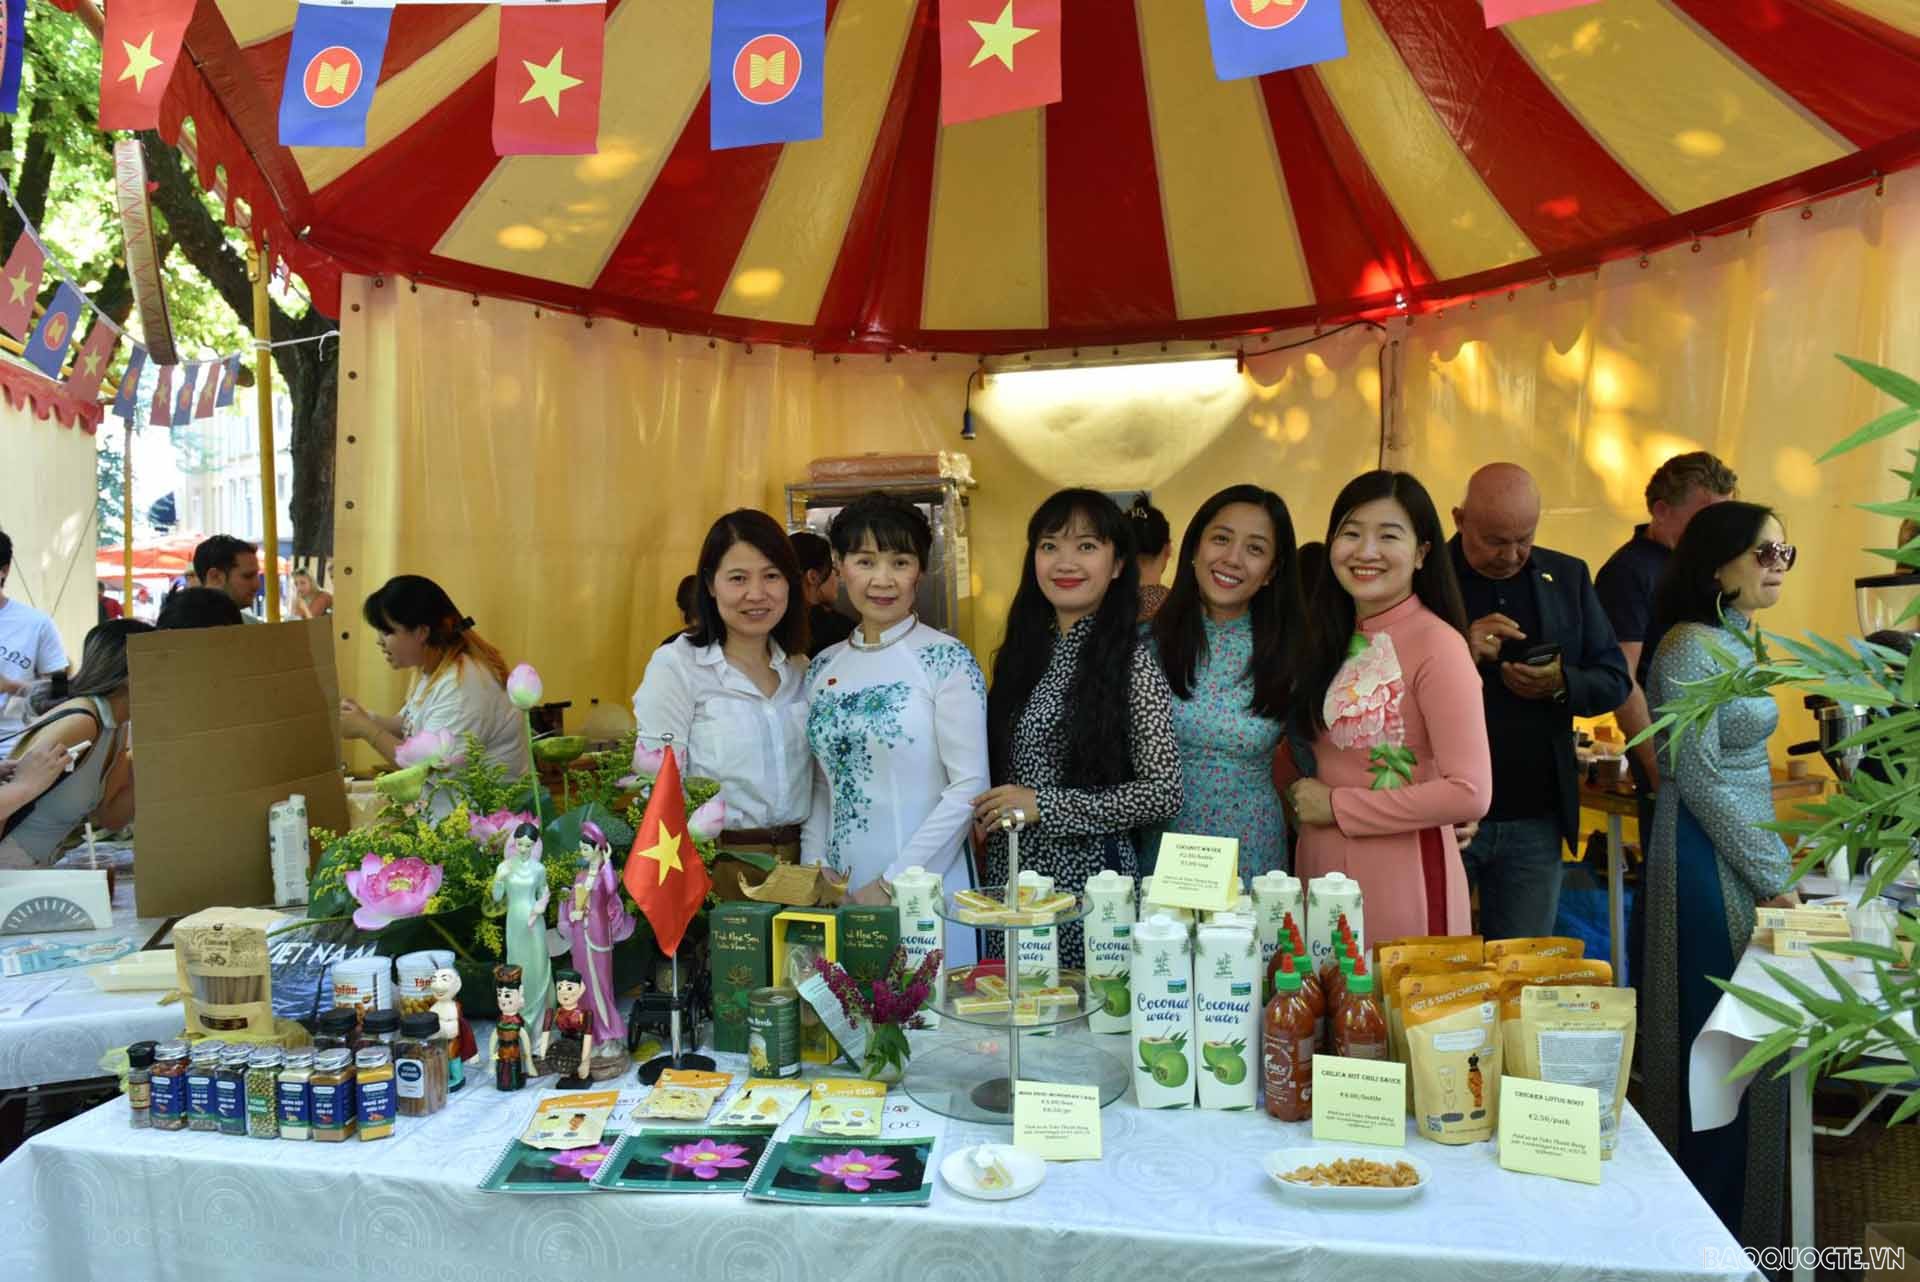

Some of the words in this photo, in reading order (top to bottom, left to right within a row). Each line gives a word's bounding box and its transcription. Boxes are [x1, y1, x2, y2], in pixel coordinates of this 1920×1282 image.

[1018, 940, 1052, 951] oconut
[1457, 982, 1492, 998] CHICKEN
[1137, 992, 1190, 1013] Coconut
[1197, 992, 1250, 1014] Coconut
[1146, 1012, 1182, 1023] water
[1204, 1013, 1241, 1025] water
